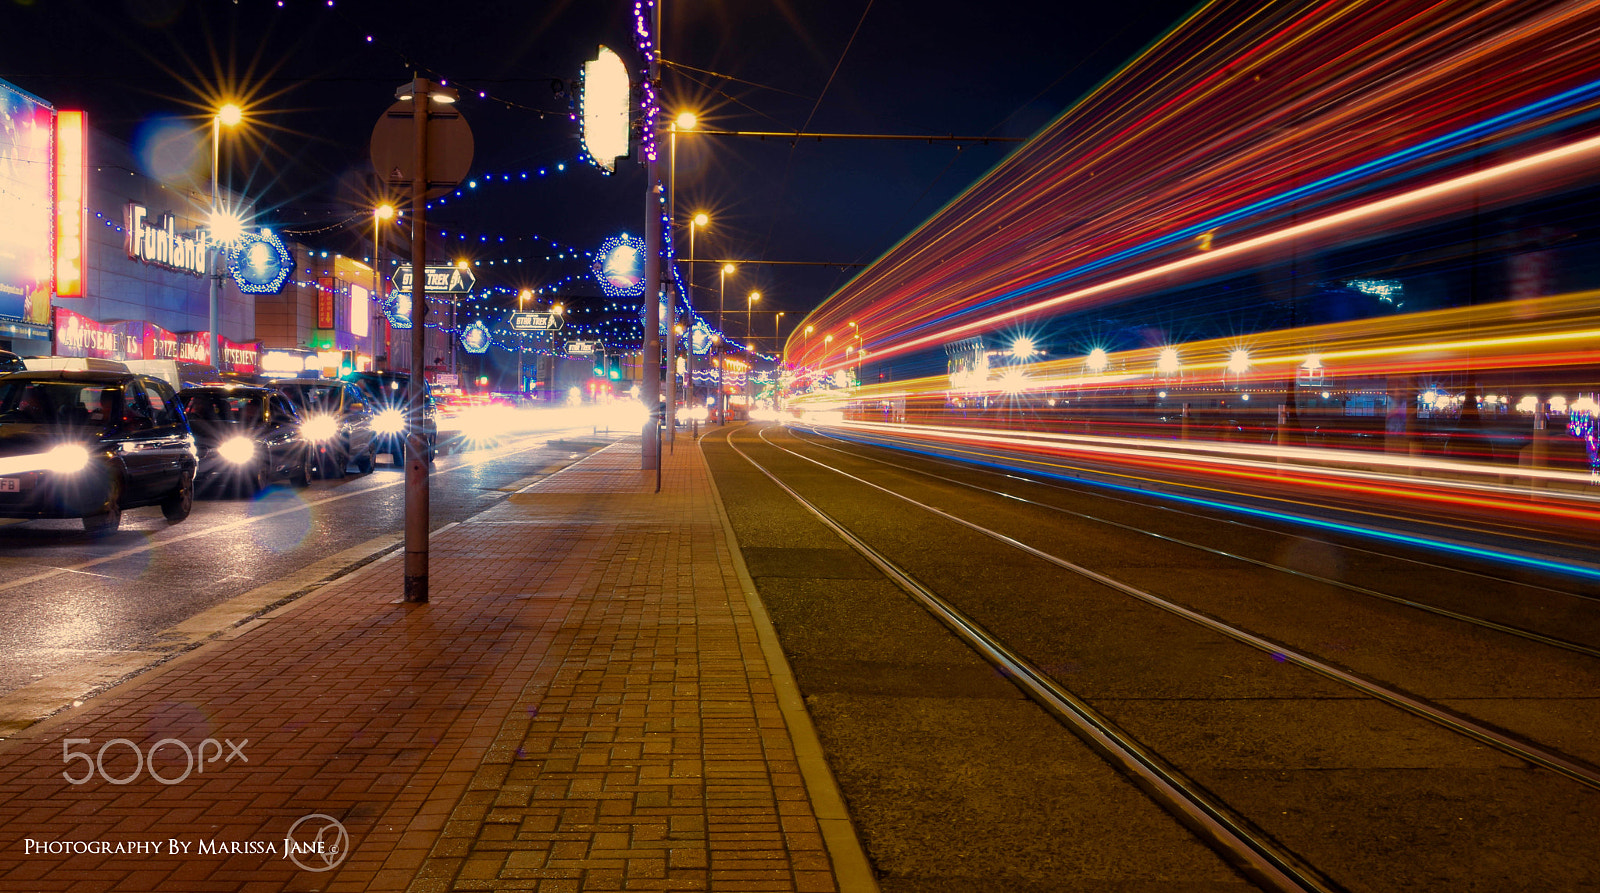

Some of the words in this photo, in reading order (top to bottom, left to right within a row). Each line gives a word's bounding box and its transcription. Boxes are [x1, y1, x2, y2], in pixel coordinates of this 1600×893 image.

[134, 205, 206, 274] Funland
[427, 273, 450, 286] TREK
[516, 317, 532, 325] STAR
[533, 317, 547, 325] TREK
[64, 327, 137, 354] AMUSEMENTS
[153, 338, 178, 357] PRIZE
[179, 342, 205, 361] BINGO
